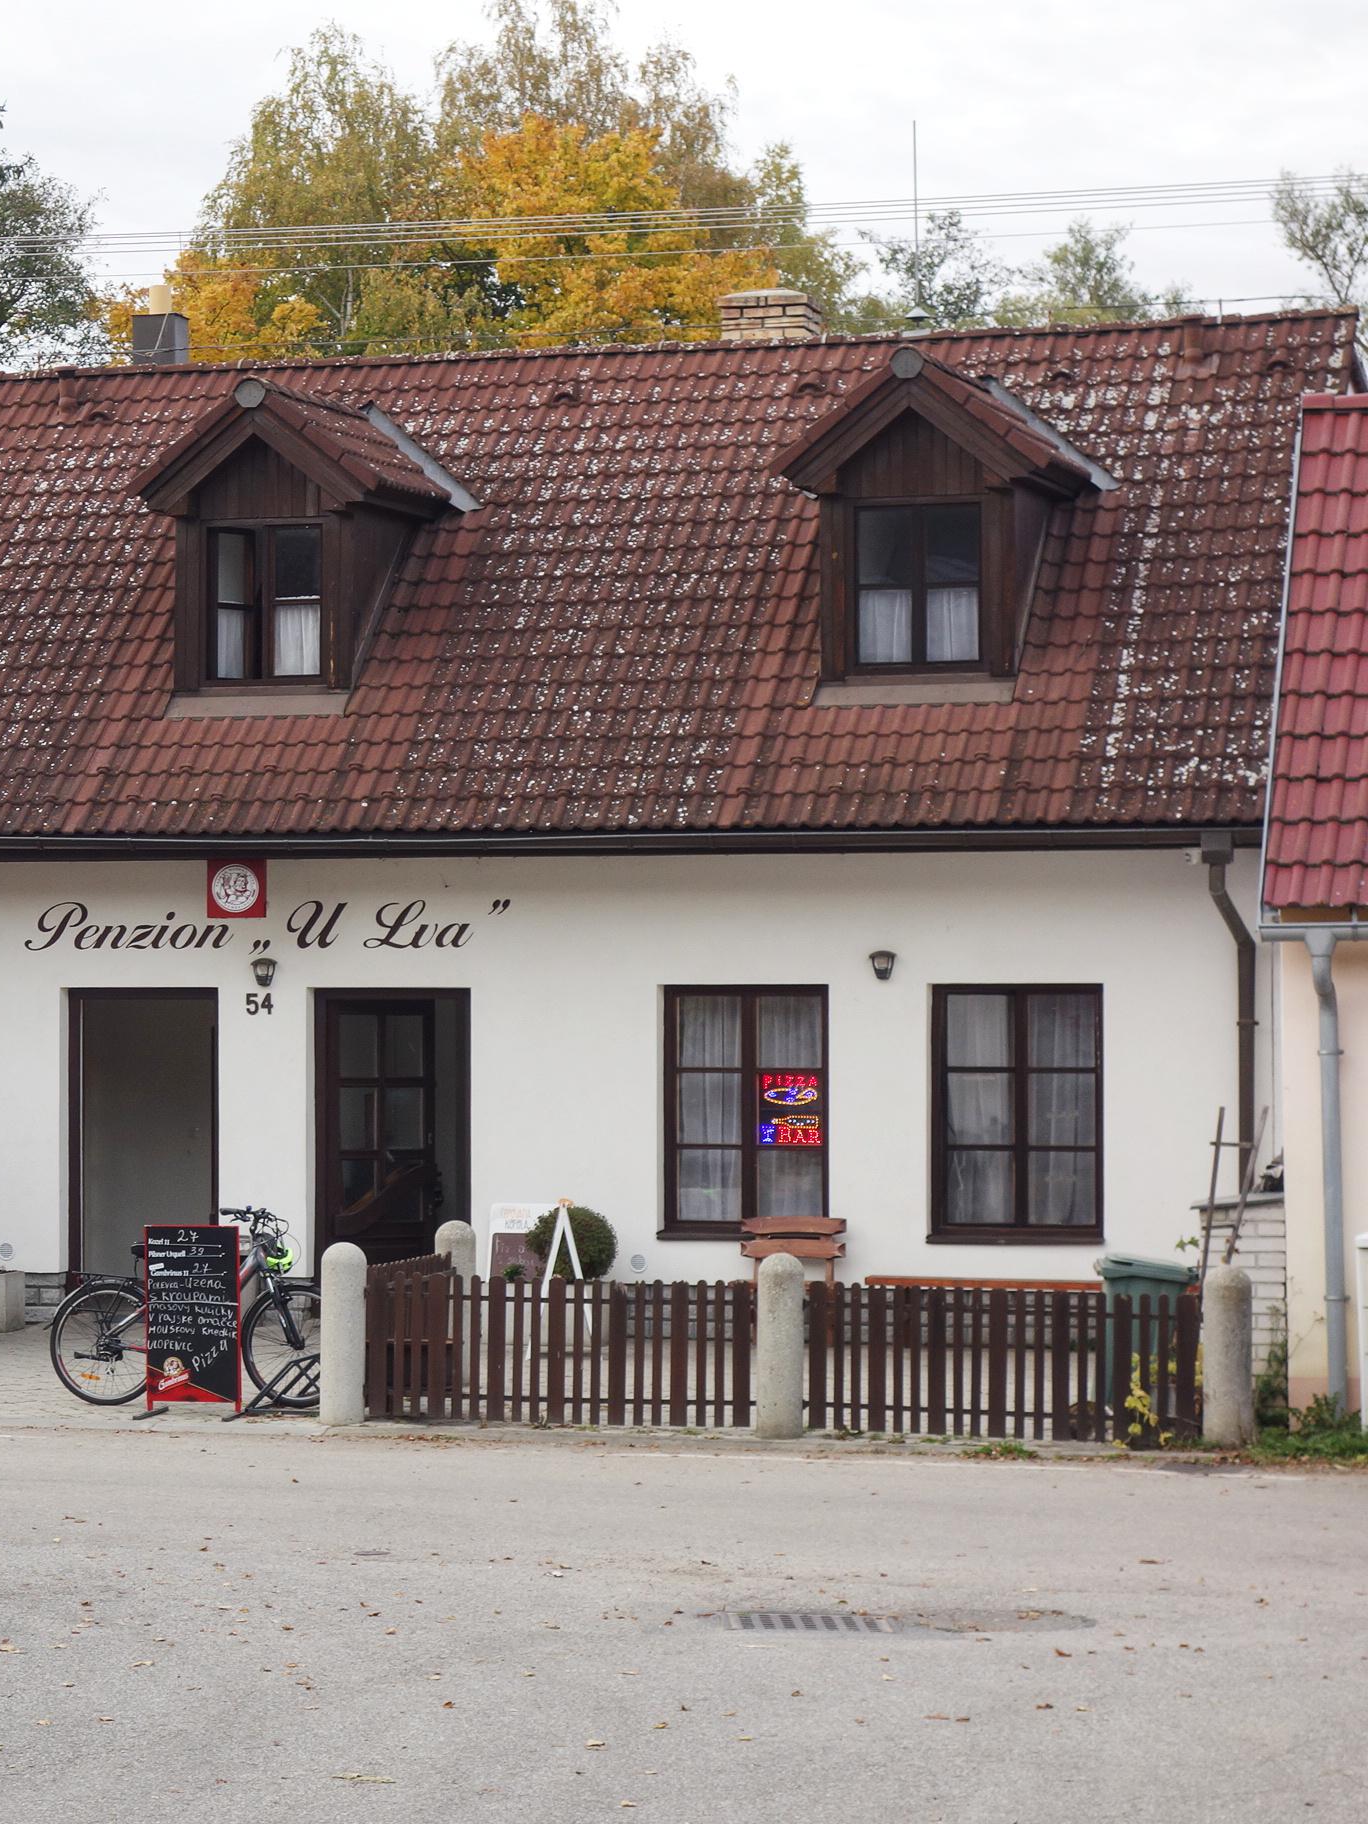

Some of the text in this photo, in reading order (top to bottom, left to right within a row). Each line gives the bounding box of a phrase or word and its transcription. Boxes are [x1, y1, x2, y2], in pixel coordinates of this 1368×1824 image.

[25, 901, 233, 951] Penzion
[245, 992, 274, 1016] 54
[762, 1074, 818, 1089] PIZZA
[777, 1125, 821, 1144] BAR
[176, 1229, 199, 1243] 27
[148, 1250, 165, 1258] Pilsner
[166, 1250, 186, 1259] Urquell
[192, 1262, 212, 1274] 27
